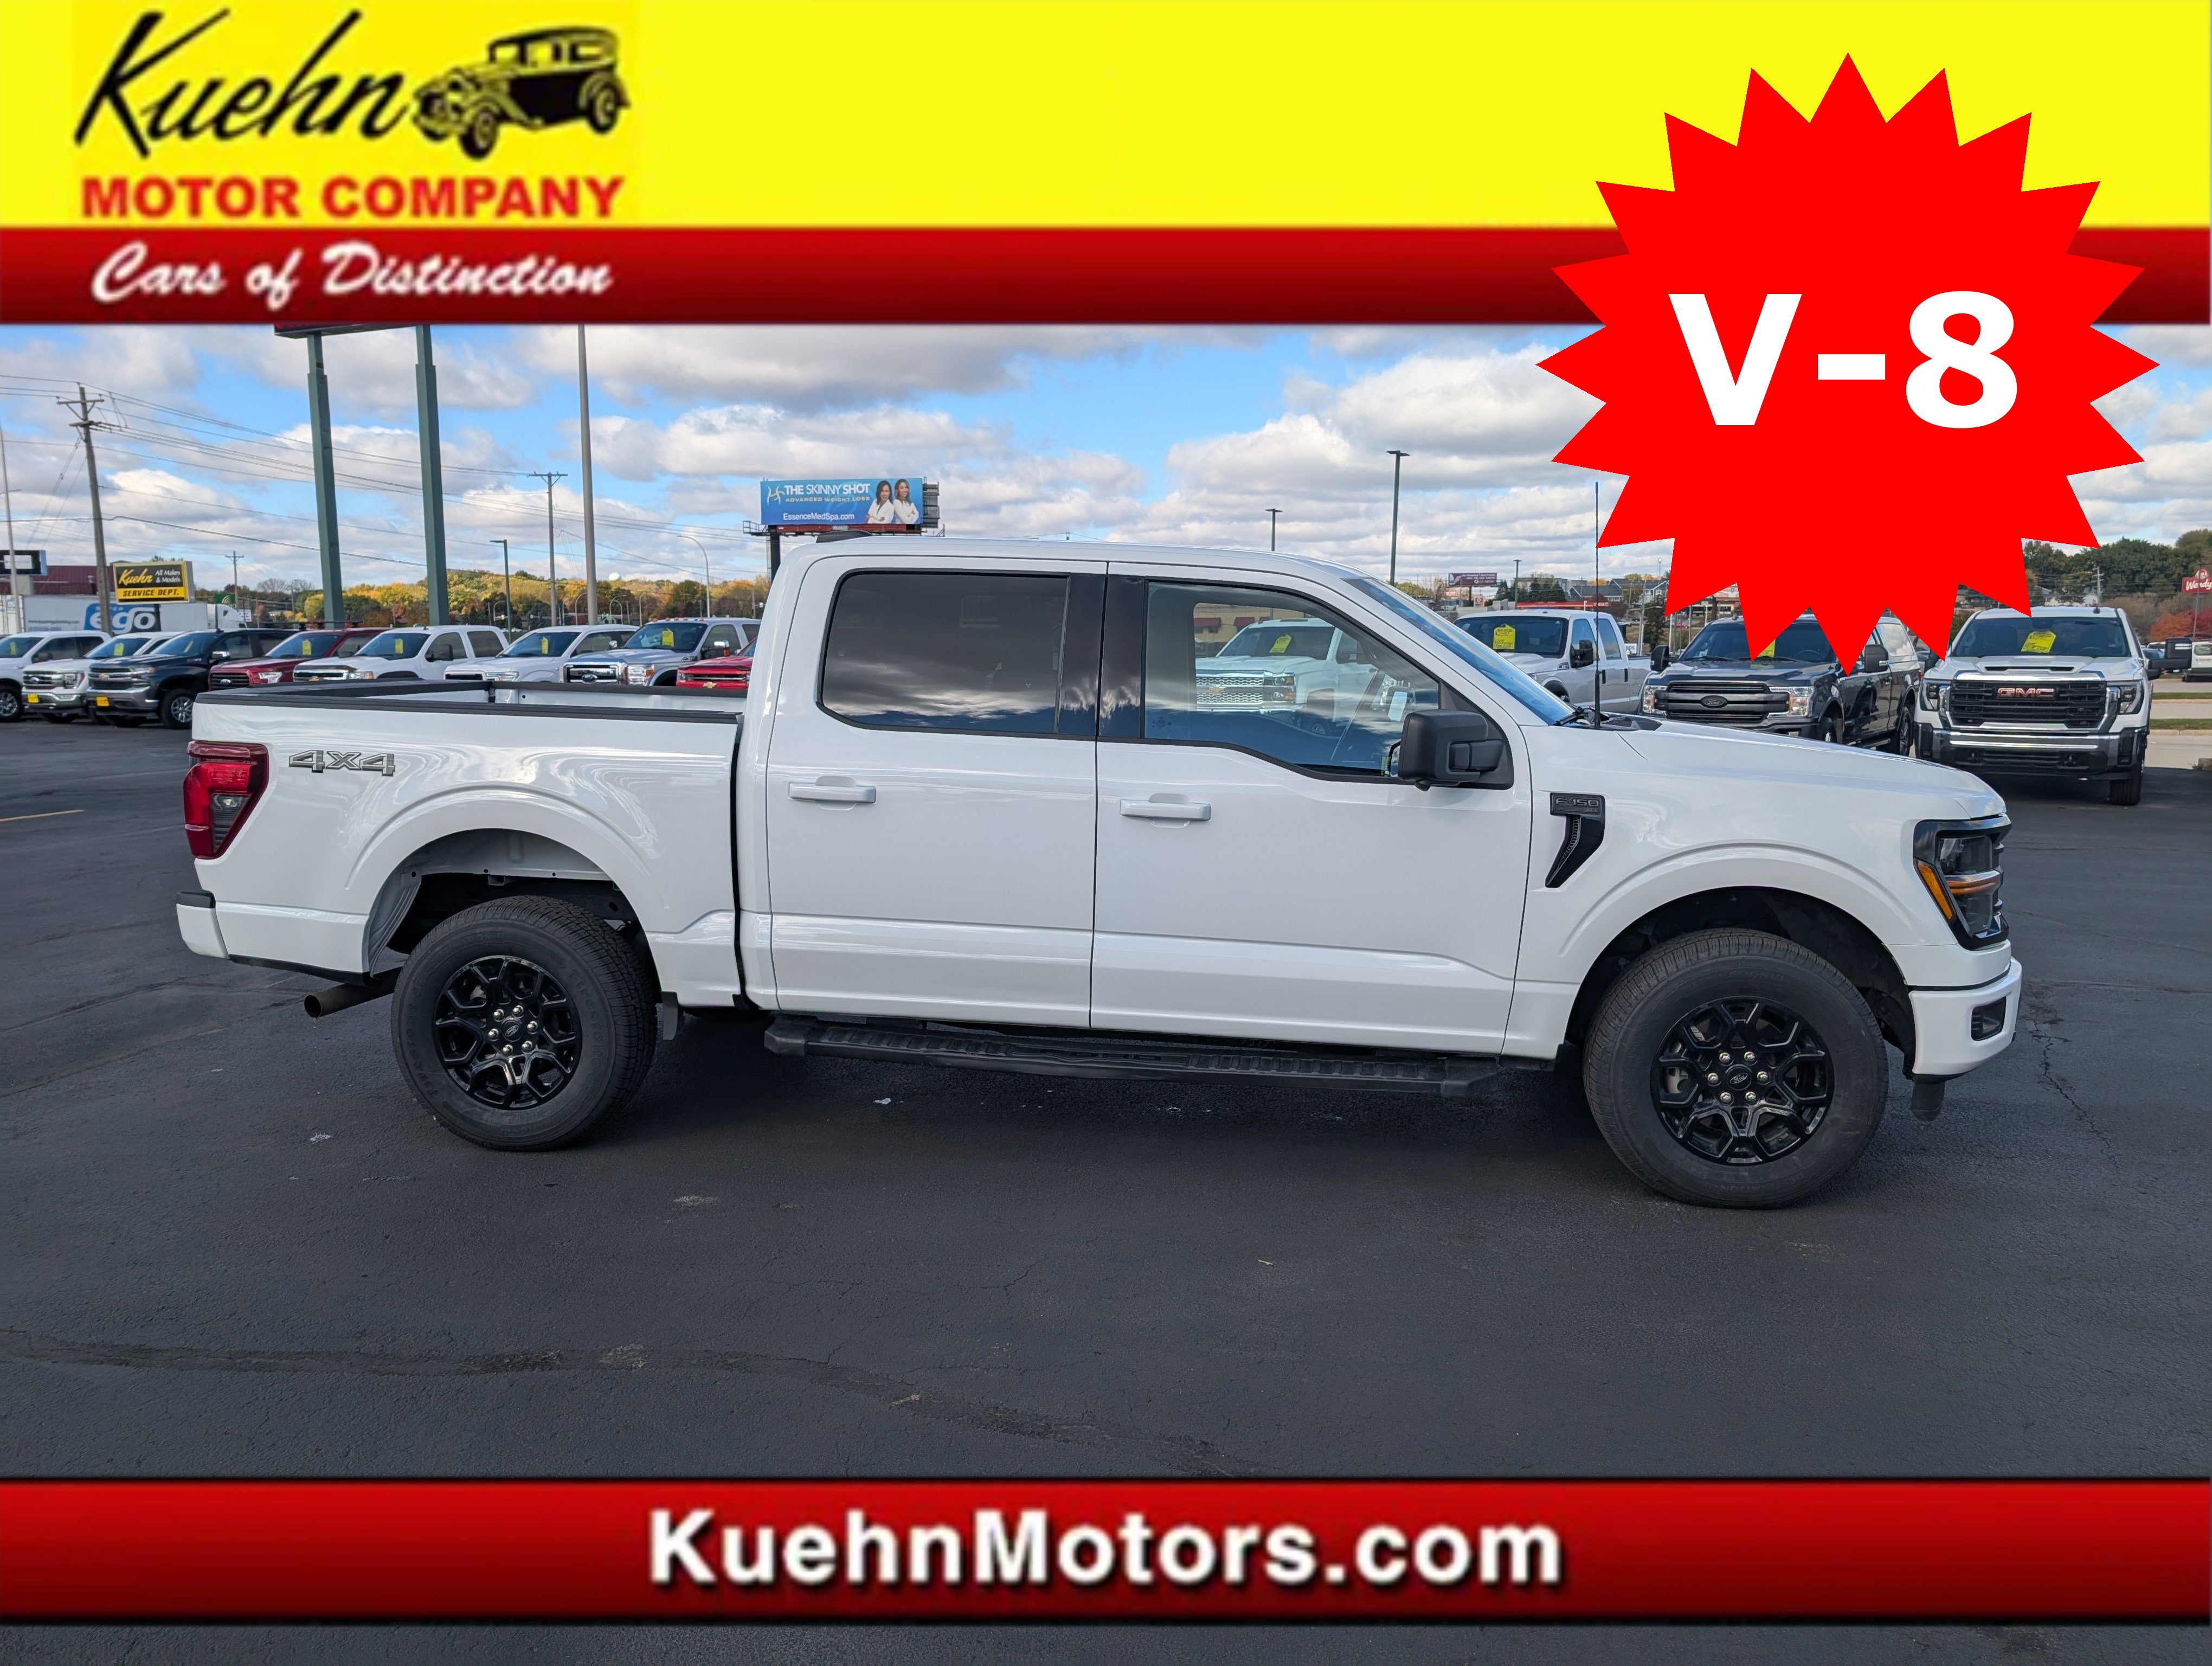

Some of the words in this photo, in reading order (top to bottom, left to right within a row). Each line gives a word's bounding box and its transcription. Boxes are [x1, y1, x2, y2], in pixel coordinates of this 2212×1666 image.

[785, 485, 804, 495] THE
[806, 484, 841, 495] SKINNY
[843, 483, 871, 495] SHOT
[783, 512, 855, 522] EssenceMedSpa.com
[119, 568, 152, 586] Kuehn
[1998, 688, 2054, 698] GMC
[1555, 798, 1599, 807] F-150
